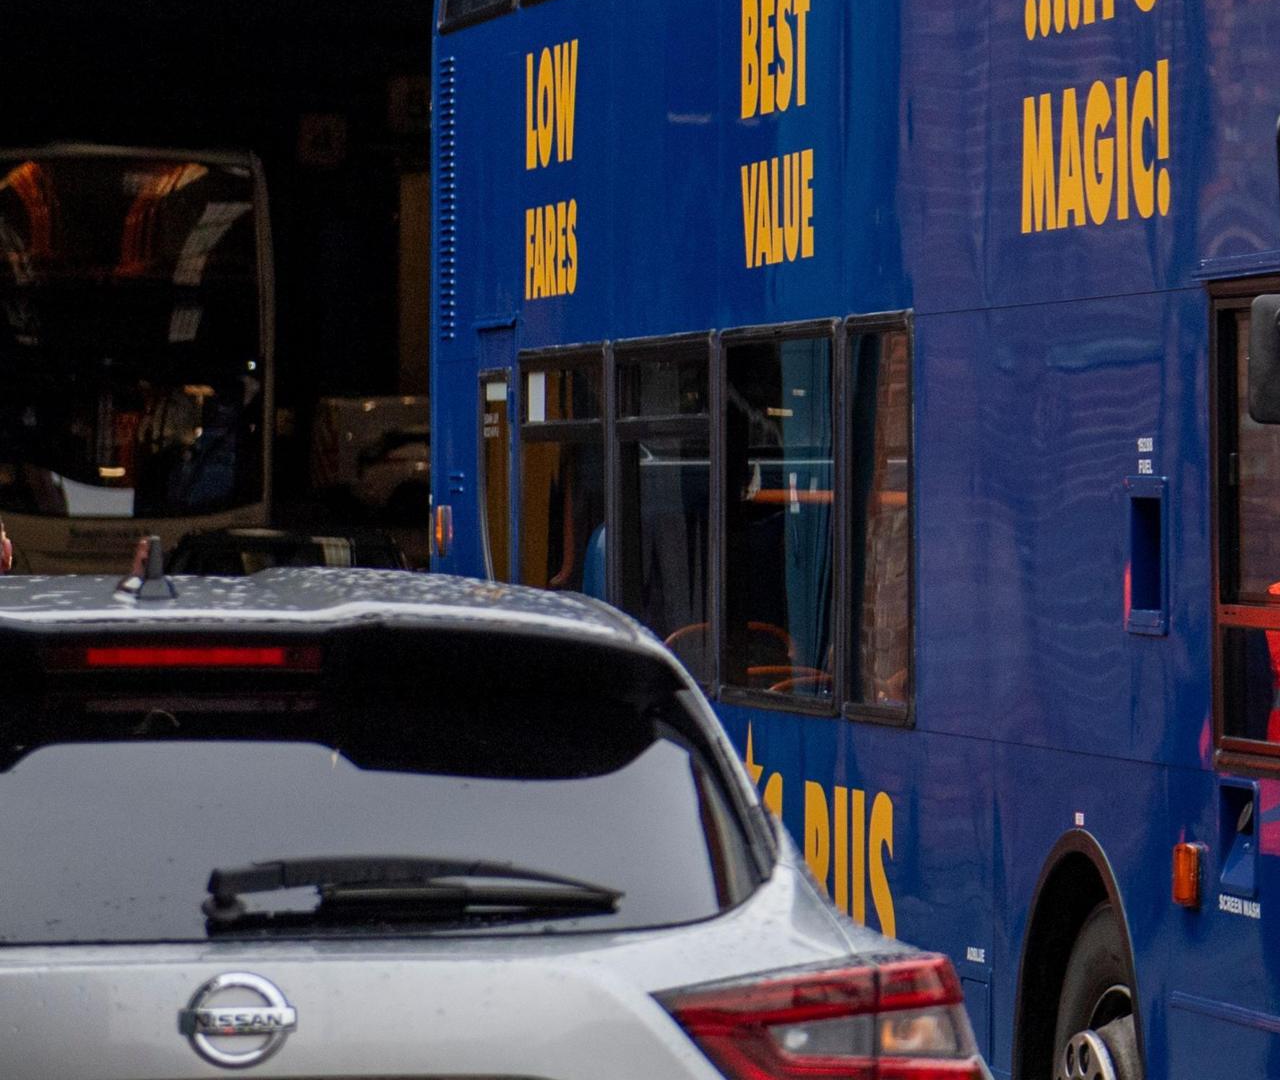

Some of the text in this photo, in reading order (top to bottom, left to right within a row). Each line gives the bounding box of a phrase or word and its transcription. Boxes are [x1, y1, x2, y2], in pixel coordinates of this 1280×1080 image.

[526, 38, 578, 170] LOW
[1022, 59, 1171, 234] MAGIC!
[525, 199, 578, 300] FARES
[741, 149, 815, 269] VALUE
[1138, 459, 1153, 474] FUEL
[1219, 893, 1261, 919] SCREEN WASH
[196, 1012, 282, 1027] NISSAN
